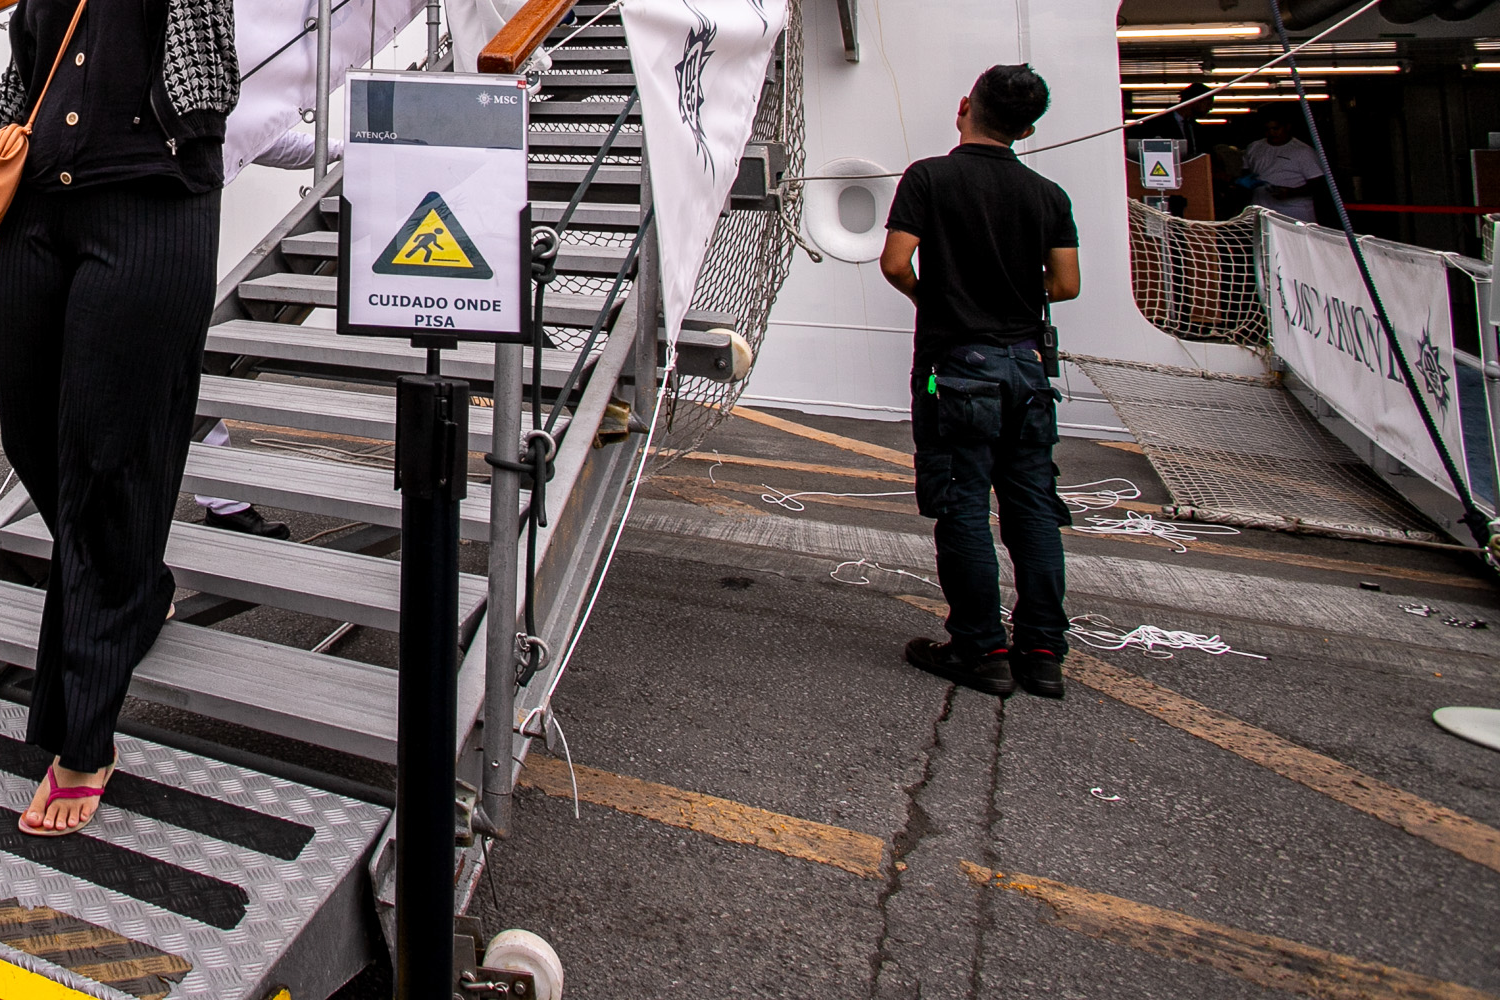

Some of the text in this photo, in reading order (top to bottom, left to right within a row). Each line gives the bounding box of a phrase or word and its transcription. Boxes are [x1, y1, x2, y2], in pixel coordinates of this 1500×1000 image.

[494, 95, 519, 105] MSC
[355, 130, 398, 141] ATENÇÃO
[368, 293, 502, 312] CUIDADO ONDE
[414, 314, 456, 328] PISA
